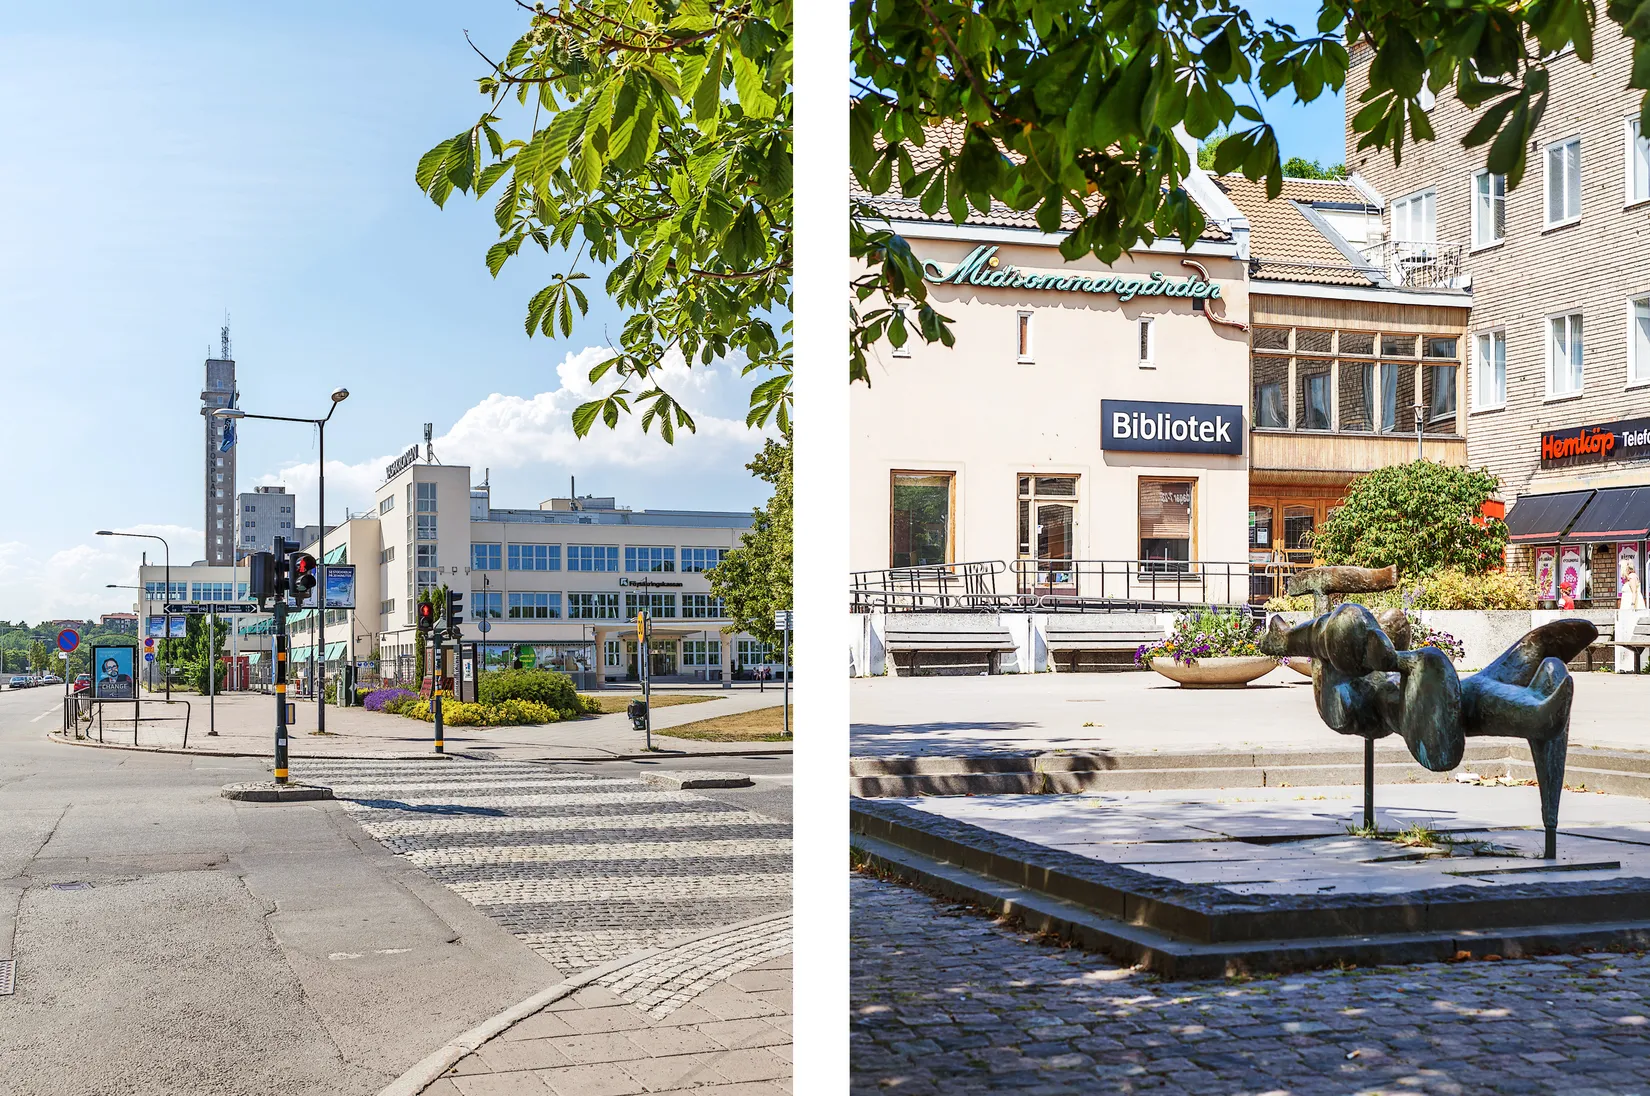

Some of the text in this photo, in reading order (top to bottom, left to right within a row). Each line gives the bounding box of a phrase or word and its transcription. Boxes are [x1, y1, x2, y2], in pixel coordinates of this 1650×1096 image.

[923, 244, 1221, 302] Midsommargården
[1112, 412, 1232, 443] Bibliotek
[1542, 427, 1614, 460] Hemköp
